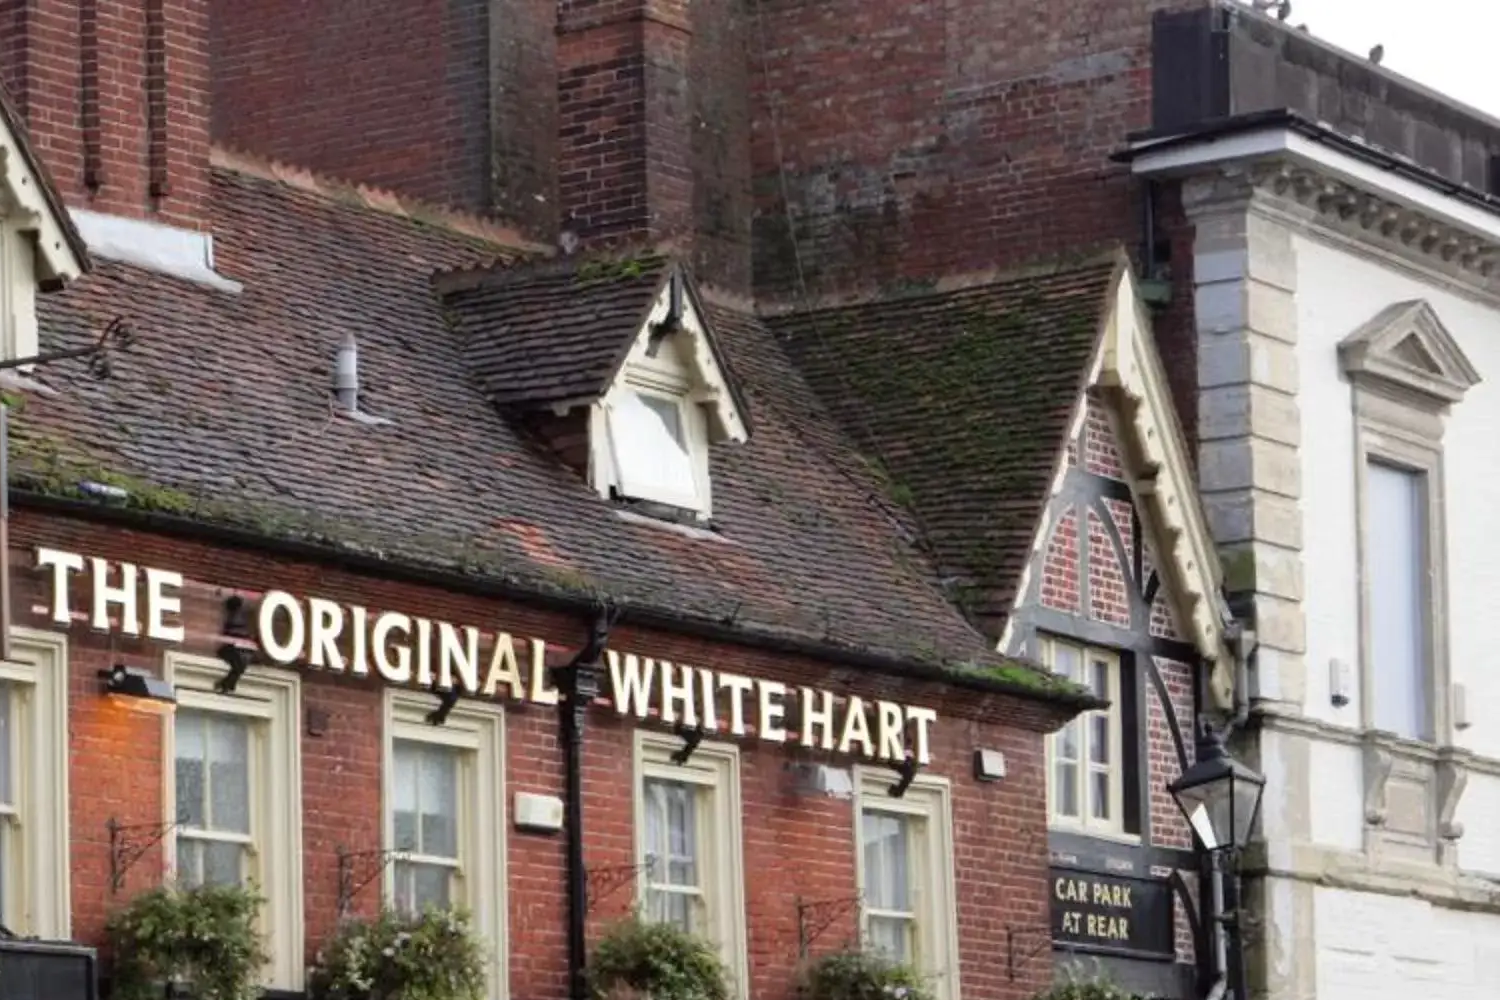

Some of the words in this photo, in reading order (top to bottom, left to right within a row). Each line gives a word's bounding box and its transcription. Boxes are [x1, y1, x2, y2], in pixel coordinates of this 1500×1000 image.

[36, 547, 186, 643] THE
[258, 589, 561, 705] ORIGINAL
[605, 648, 788, 742] WHITE
[801, 686, 937, 765] HART
[1055, 877, 1088, 903] CAR
[1092, 882, 1133, 909] PARK
[1061, 911, 1082, 934] AT
[1086, 914, 1130, 941] REAR
